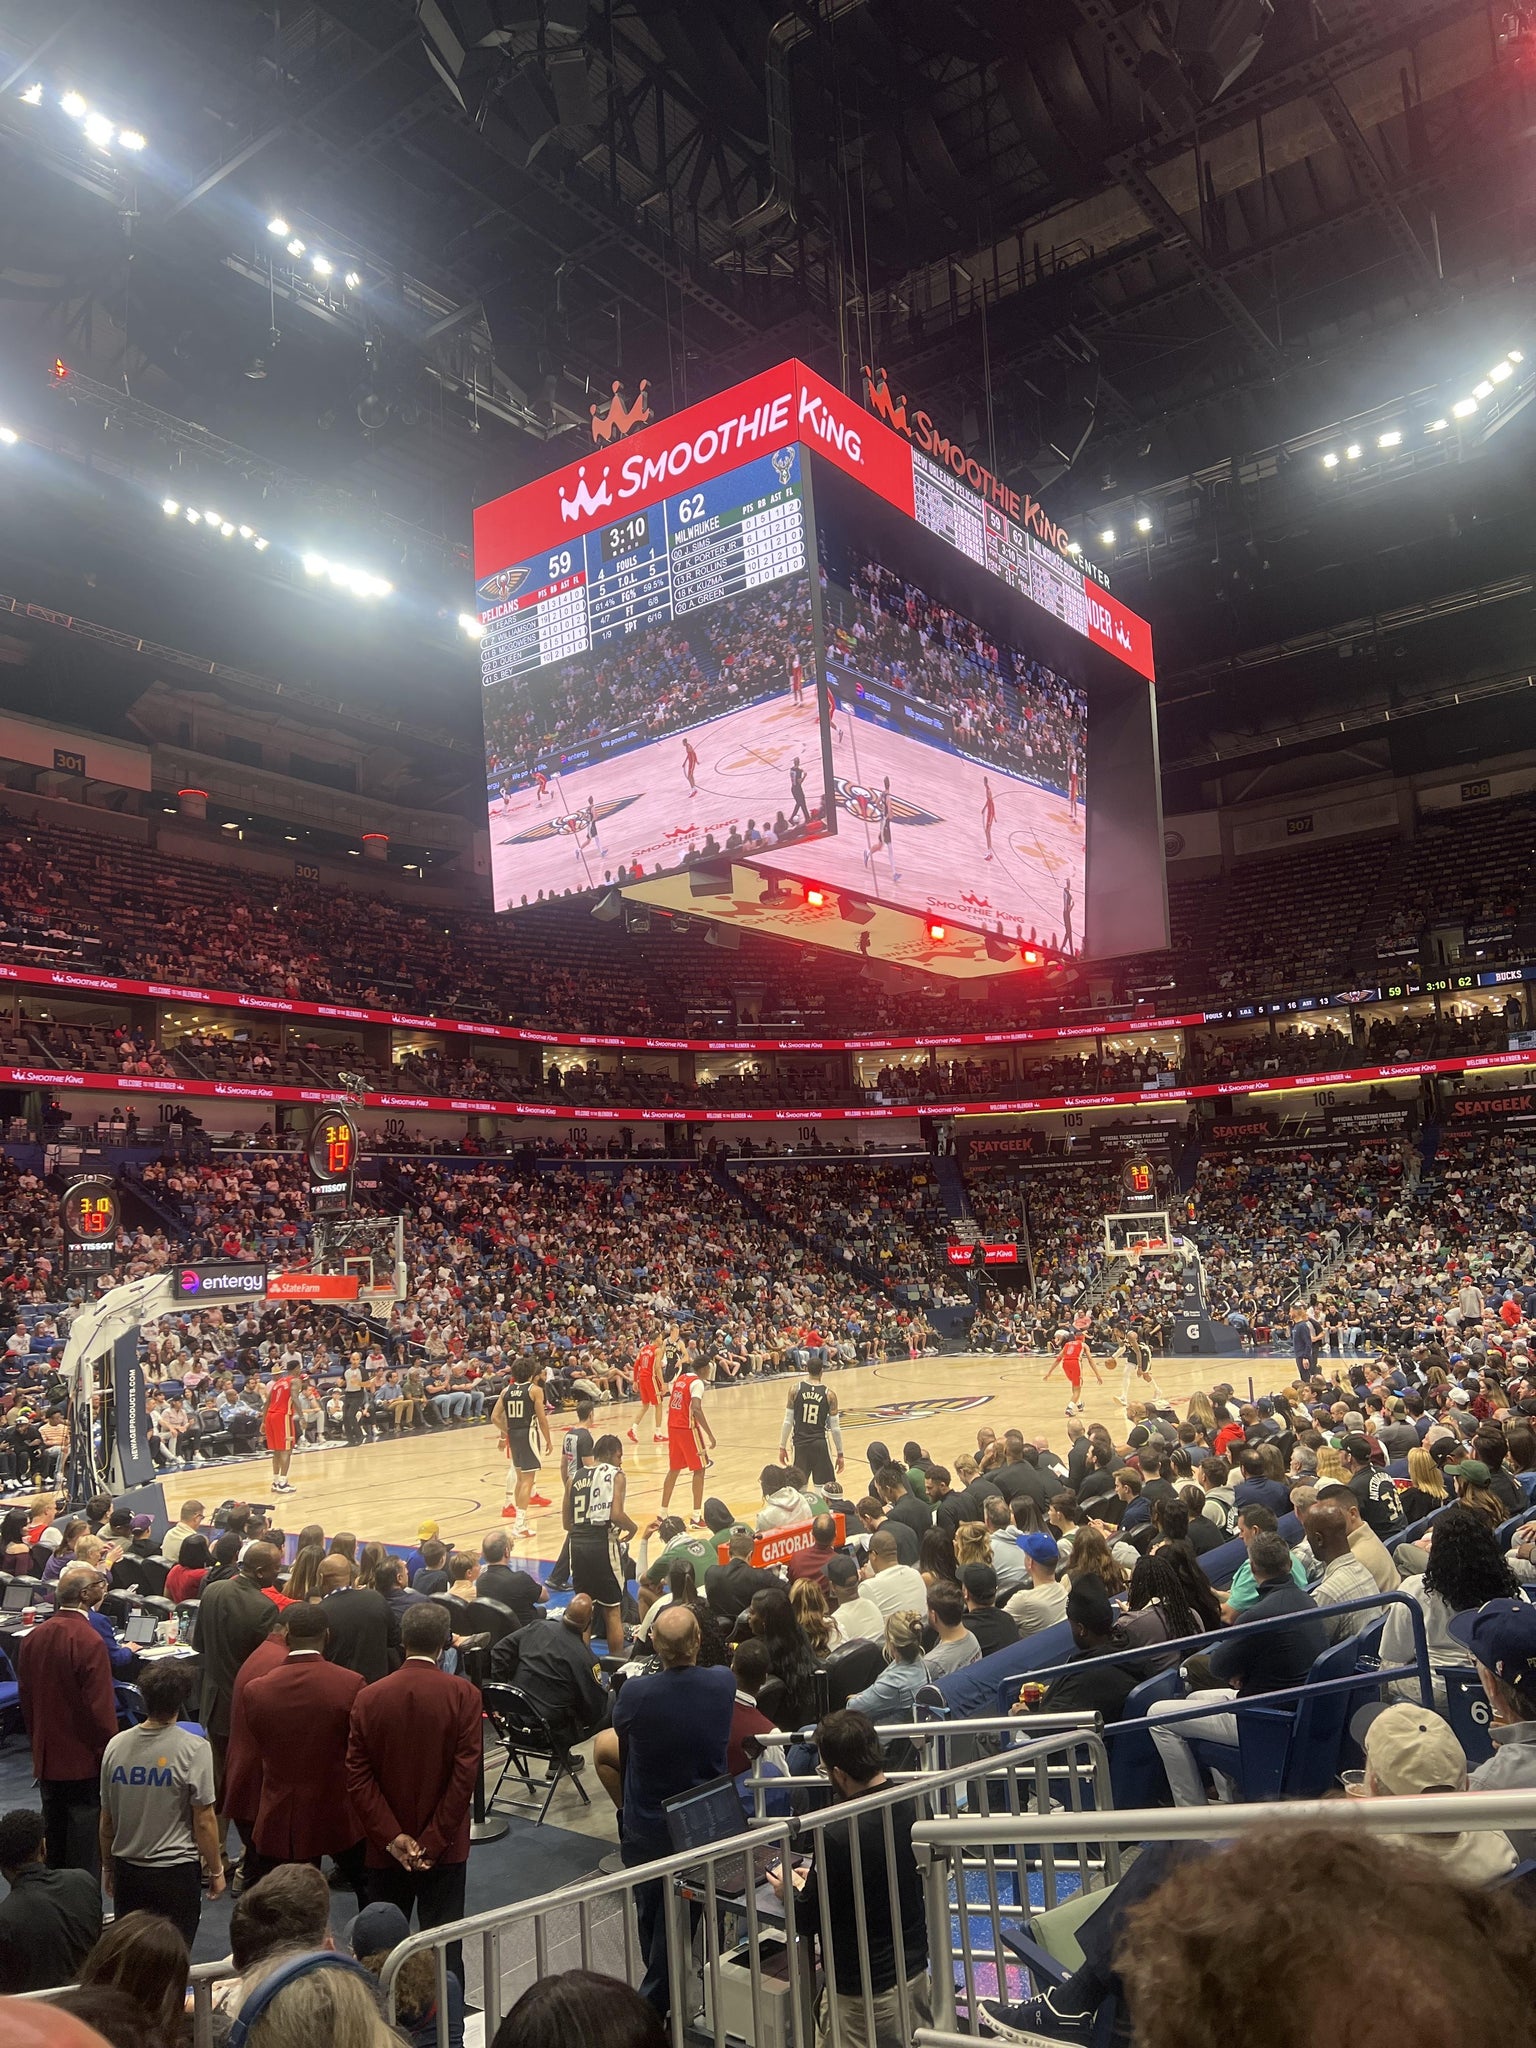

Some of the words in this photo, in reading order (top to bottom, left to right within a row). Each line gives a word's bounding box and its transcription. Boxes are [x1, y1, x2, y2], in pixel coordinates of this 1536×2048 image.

[618, 393, 793, 498] SMOOTHIE
[679, 493, 706, 523] 62
[911, 411, 1020, 521] SMOOTHIE
[1072, 553, 1111, 590] CENTER
[674, 515, 720, 545] MILWAUKEE
[742, 504, 754, 515] PTS
[770, 491, 782, 504] AST
[786, 487, 794, 497] FL
[990, 512, 1001, 530] 59
[609, 517, 646, 547] 3:10
[1012, 529, 1023, 547] 62
[692, 538, 711, 551] SIMS
[694, 546, 726, 561] PORTER
[548, 550, 572, 579] 59
[598, 568, 605, 580] 4
[616, 555, 637, 572] FOULS
[695, 558, 728, 575] ROLLINS
[599, 584, 606, 596] 5
[649, 563, 656, 576] 5
[696, 574, 723, 590] KUZMA
[595, 598, 615, 611] 61.4%
[621, 588, 637, 602] FG%
[643, 578, 664, 592] 59.5%
[697, 588, 725, 604] GREEN
[481, 598, 519, 624] PELICANS
[626, 605, 634, 617] FT
[602, 631, 612, 640] 1/9
[624, 620, 638, 633] 3PT
[56, 753, 83, 771] 301
[631, 832, 699, 858] SMOOTHIE
[296, 865, 319, 881] 302
[927, 896, 993, 917] SMOOTHIE
[65, 975, 99, 987] SMOOTHIE
[1388, 986, 1401, 996] 59
[1426, 980, 1446, 991] 3:10
[1458, 976, 1472, 986] 62
[1495, 970, 1522, 982] BUCKS
[249, 998, 279, 1008] SMOOTHIE
[1206, 1012, 1223, 1021] FOULS
[1287, 1001, 1297, 1009] 16
[1319, 997, 1329, 1005] 13
[1390, 1067, 1421, 1075] SMOOTHIE
[1466, 1058, 1489, 1066] WELCOME
[27, 1072, 65, 1083] SMOOTHIE
[1228, 1084, 1255, 1092] SMOOTHIE
[1312, 1091, 1336, 1107] 106
[1454, 1094, 1534, 1117] SEATGEEK
[385, 1118, 405, 1136] 102
[1062, 1113, 1083, 1128] 105
[325, 1124, 350, 1143] 3:10
[569, 1128, 588, 1142] 103
[798, 1126, 817, 1140] 104
[1213, 1122, 1270, 1138] SEATGEEK
[970, 1138, 1033, 1154] SEATGEEK
[328, 1142, 349, 1172] 19
[1131, 1165, 1149, 1176] 3:10
[1133, 1174, 1149, 1190] 19
[80, 1198, 110, 1213] 3:10
[84, 1212, 105, 1232] 19
[202, 1274, 263, 1291] entergy
[1186, 1324, 1200, 1340] G
[507, 1400, 524, 1418] 00
[670, 1391, 683, 1409] 22
[129, 1369, 139, 1461] NEWAGEPRODUCTS.COM
[802, 1403, 819, 1425] 18
[761, 1530, 817, 1563] GATORAD
[1471, 1701, 1489, 1725] 6
[111, 1765, 172, 1787] ABM
